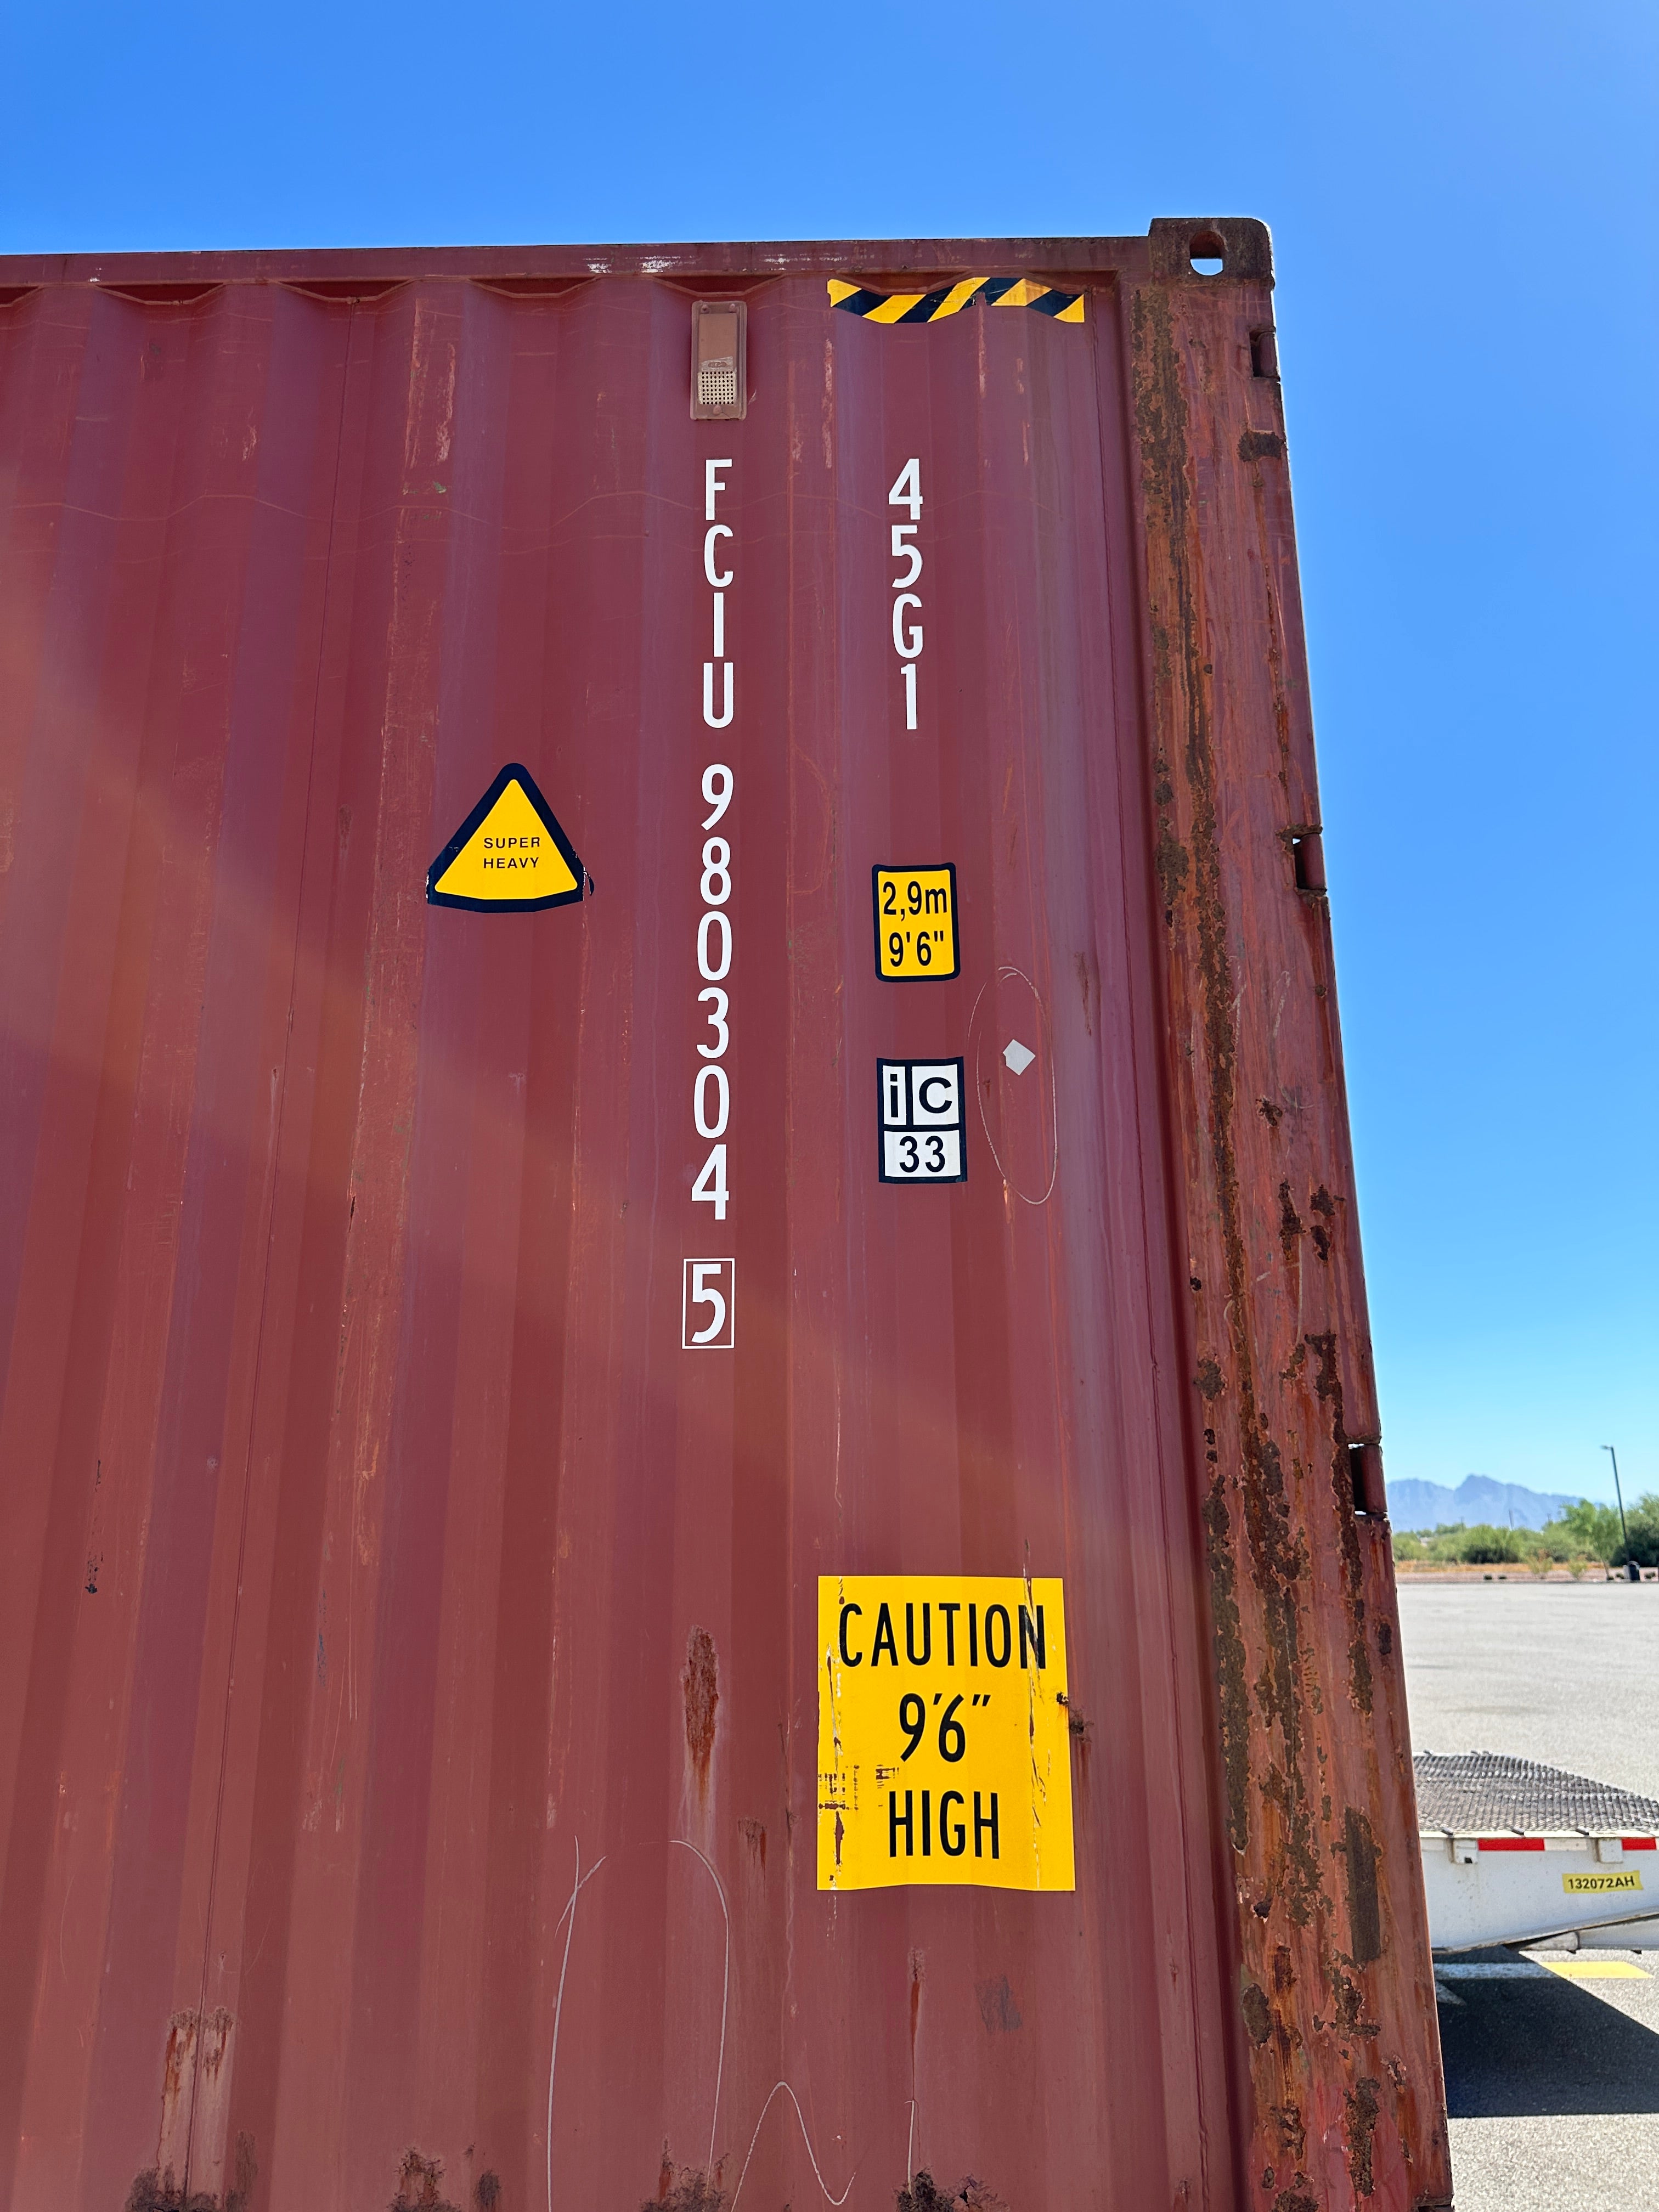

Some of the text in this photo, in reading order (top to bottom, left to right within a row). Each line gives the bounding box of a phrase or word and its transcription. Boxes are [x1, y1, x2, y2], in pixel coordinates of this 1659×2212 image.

[888, 458, 923, 730] 45G1
[483, 837, 540, 849] SUPER
[483, 856, 539, 869] HEAVY
[691, 459, 734, 1344] FCIU 980304 5
[883, 881, 947, 922] 2,9m
[899, 1135, 945, 1173] 33
[839, 1602, 1046, 1669] CAUTION
[889, 1790, 1000, 1860] HIGH
[1568, 1875, 1635, 1889] 132072AH
